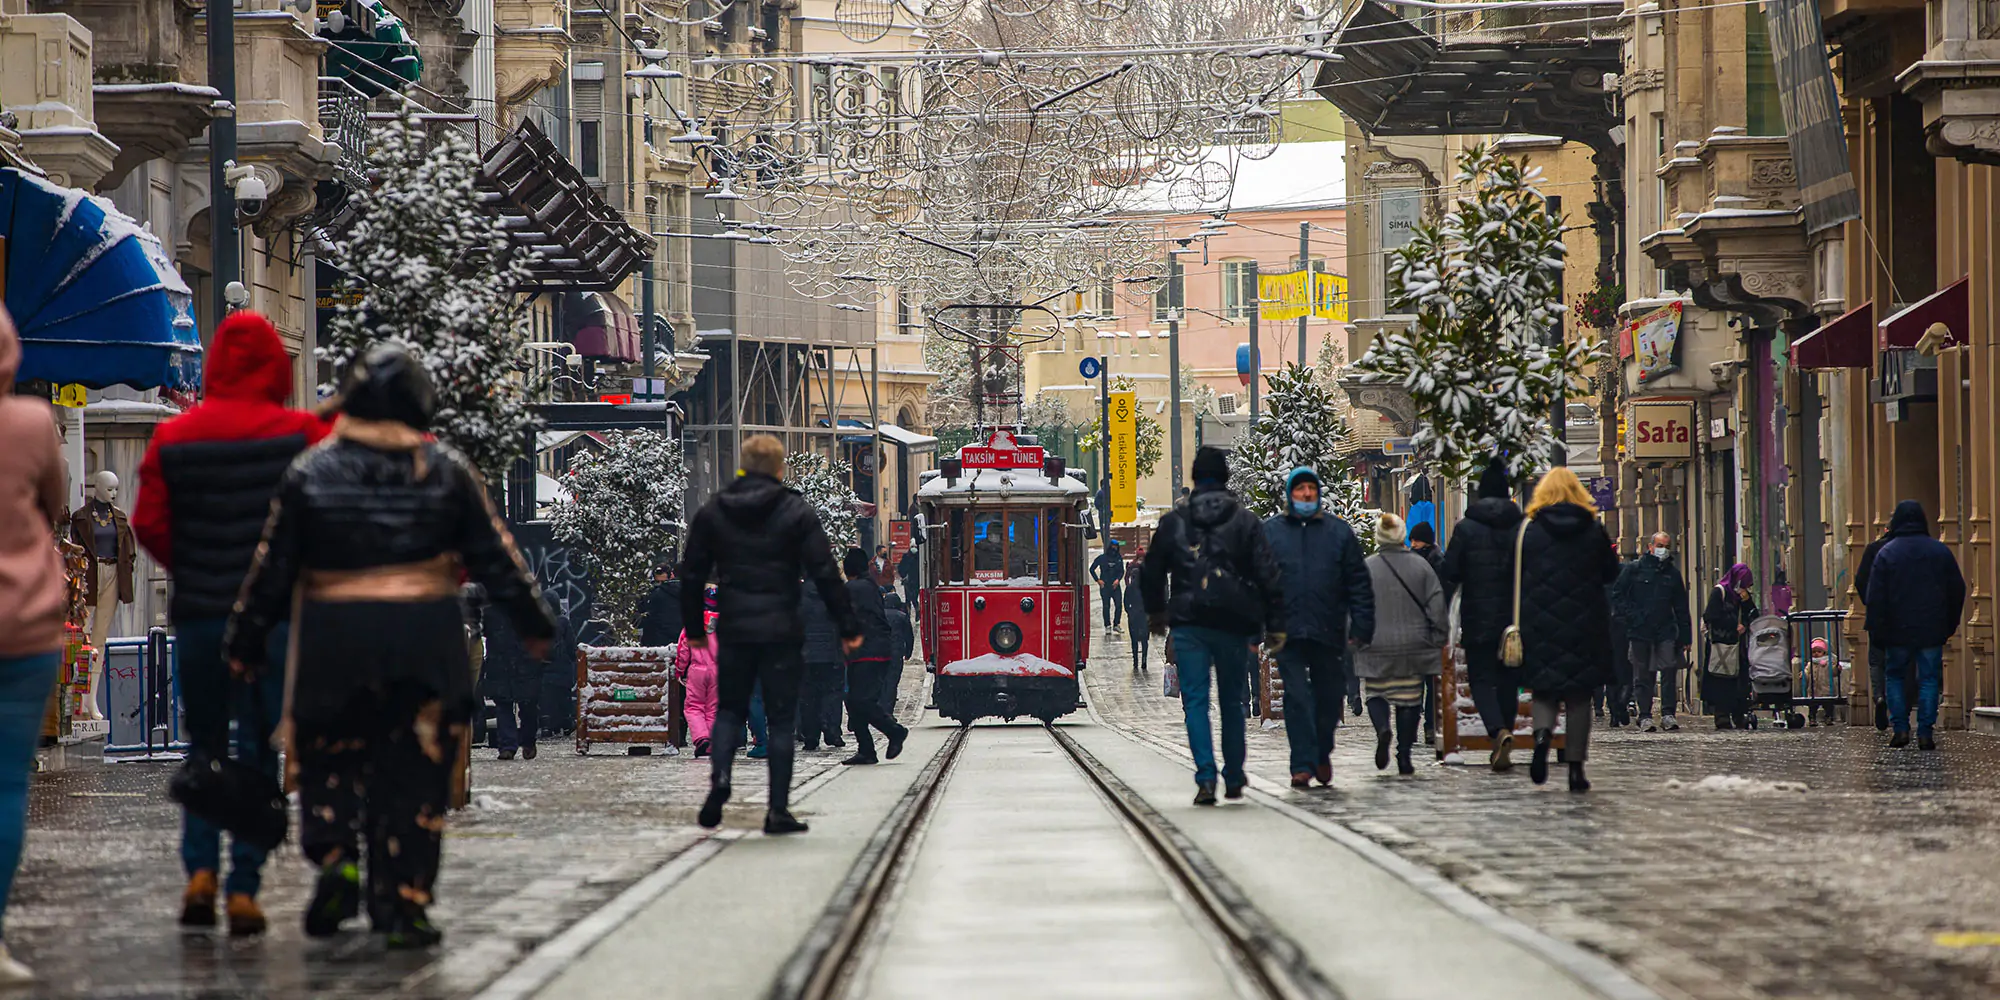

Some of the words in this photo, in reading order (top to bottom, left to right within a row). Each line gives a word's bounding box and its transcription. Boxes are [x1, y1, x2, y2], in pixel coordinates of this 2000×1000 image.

[1637, 419, 1689, 443] Safa
[964, 450, 995, 464] TAKSİM
[1012, 450, 1039, 464] TÜNEL
